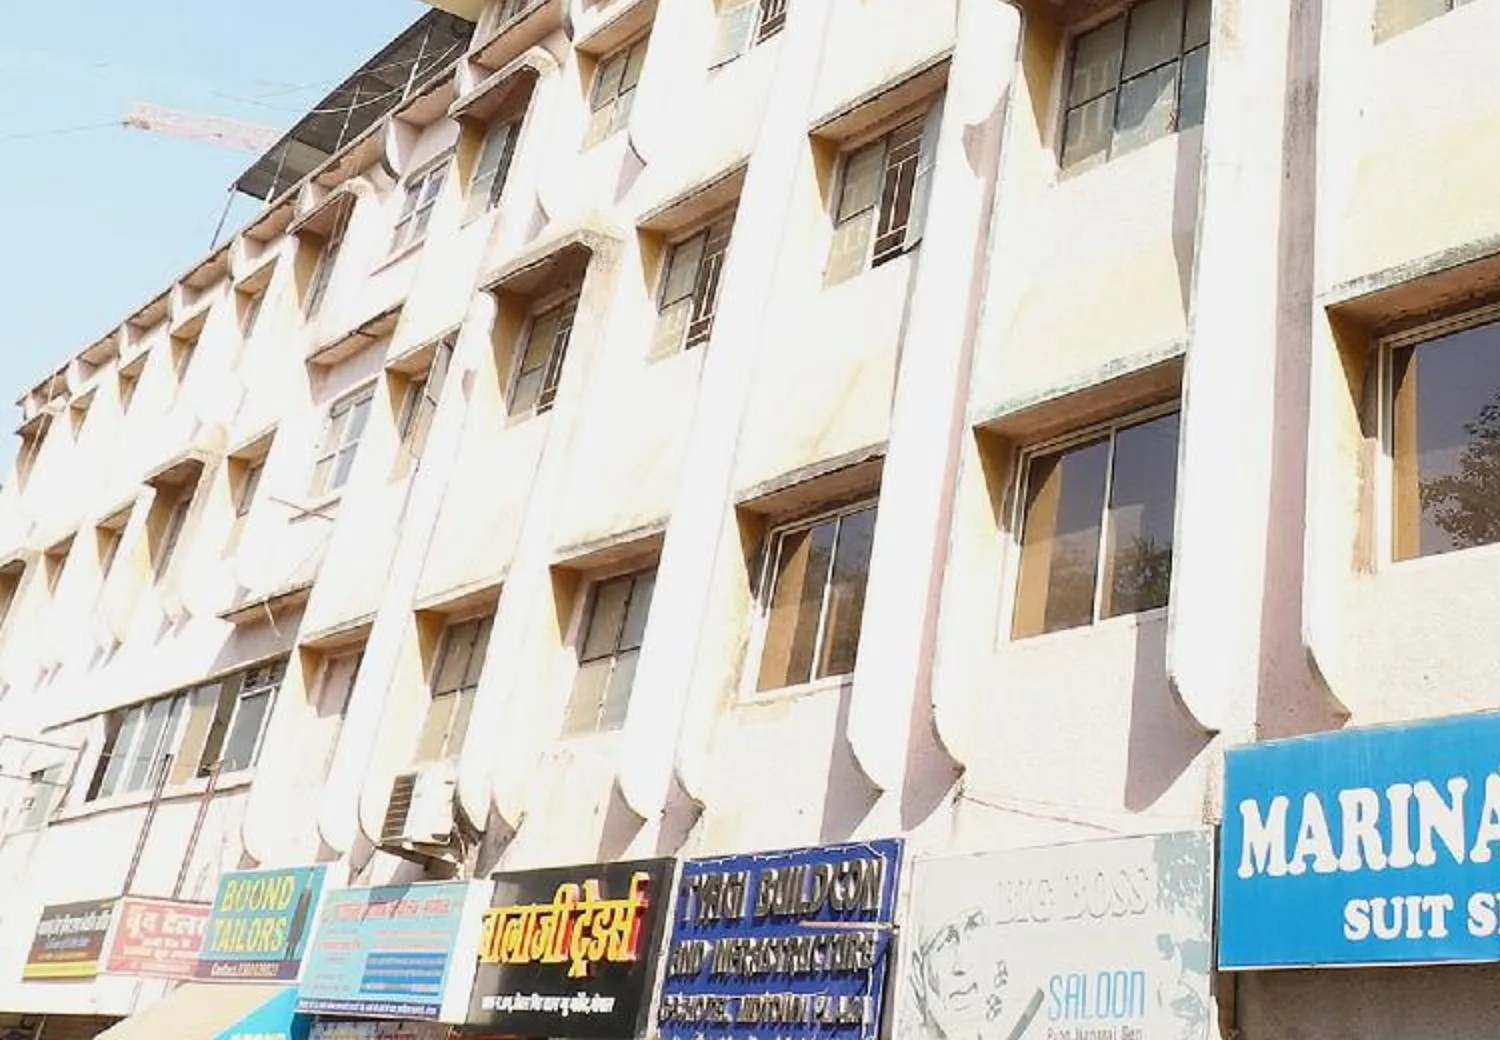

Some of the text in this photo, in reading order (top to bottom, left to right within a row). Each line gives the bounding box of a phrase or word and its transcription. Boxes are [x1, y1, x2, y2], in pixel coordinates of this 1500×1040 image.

[755, 858, 882, 917] BUILDCON
[212, 917, 287, 953] TAILORS
[1343, 894, 1454, 941] SUIT
[1048, 970, 1146, 1022] SALOON
